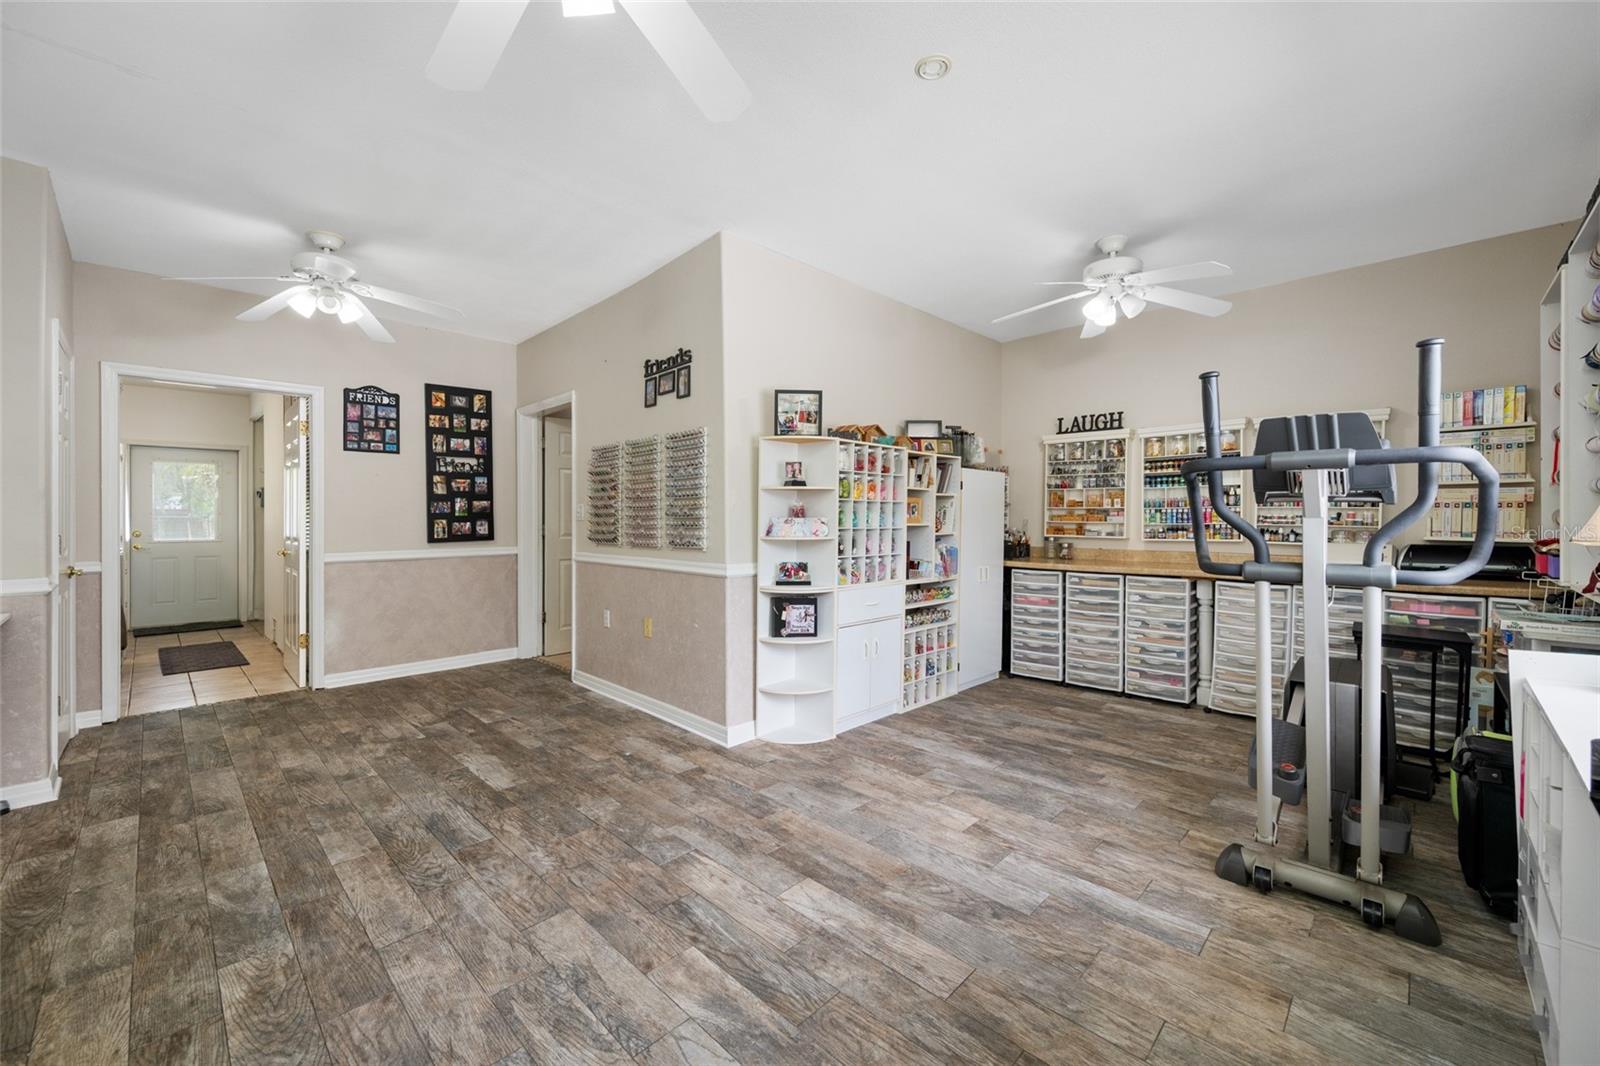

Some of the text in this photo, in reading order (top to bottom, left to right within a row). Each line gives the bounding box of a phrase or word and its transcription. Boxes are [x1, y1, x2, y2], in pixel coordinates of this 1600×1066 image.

[643, 348, 692, 377] friends
[349, 392, 396, 405] FRIENDS
[1056, 411, 1124, 435] LAUGH
